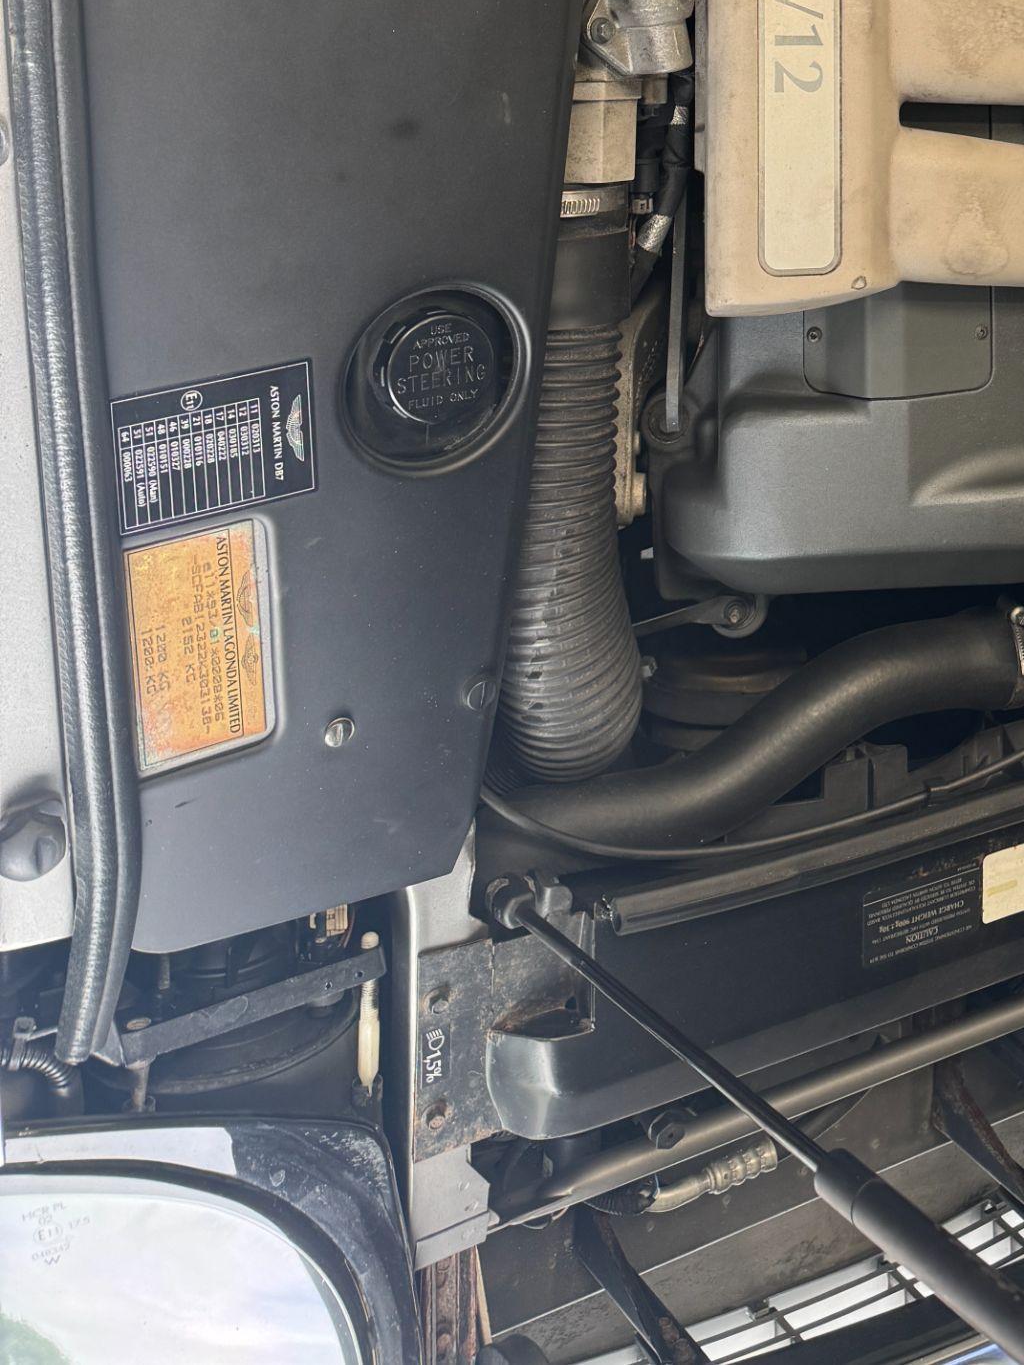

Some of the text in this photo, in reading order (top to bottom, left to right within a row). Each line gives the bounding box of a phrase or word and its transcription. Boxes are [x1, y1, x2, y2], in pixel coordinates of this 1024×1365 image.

[431, 323, 452, 335] USE
[413, 333, 470, 349] APPROVED
[410, 346, 473, 372] POWER
[397, 364, 485, 394] STEERING
[409, 389, 478, 410] FLUID ONLY
[216, 411, 224, 421] 17
[227, 409, 235, 419] 14
[239, 407, 247, 417] 12
[250, 404, 259, 414] 11
[180, 419, 189, 429] 39
[193, 416, 201, 426] 21
[204, 414, 212, 424] 18
[133, 429, 142, 439] 51
[145, 427, 154, 436] 51
[157, 424, 166, 434] 48
[169, 422, 177, 432] 46
[270, 386, 284, 480] ASTON MARTIN DB7
[122, 432, 130, 442] 64
[136, 482, 147, 507] (Auto)
[149, 480, 158, 503] (Man)
[216, 536, 241, 733] ASTON MARTIN LAGONDA LIMITED
[182, 617, 196, 683] 2152 KG
[146, 676, 156, 694] KG
[939, 900, 964, 914] CHARGE
[911, 909, 937, 924] WEIGHT
[905, 926, 938, 944] CAUTION
[423, 1050, 442, 1083] 1,5%
